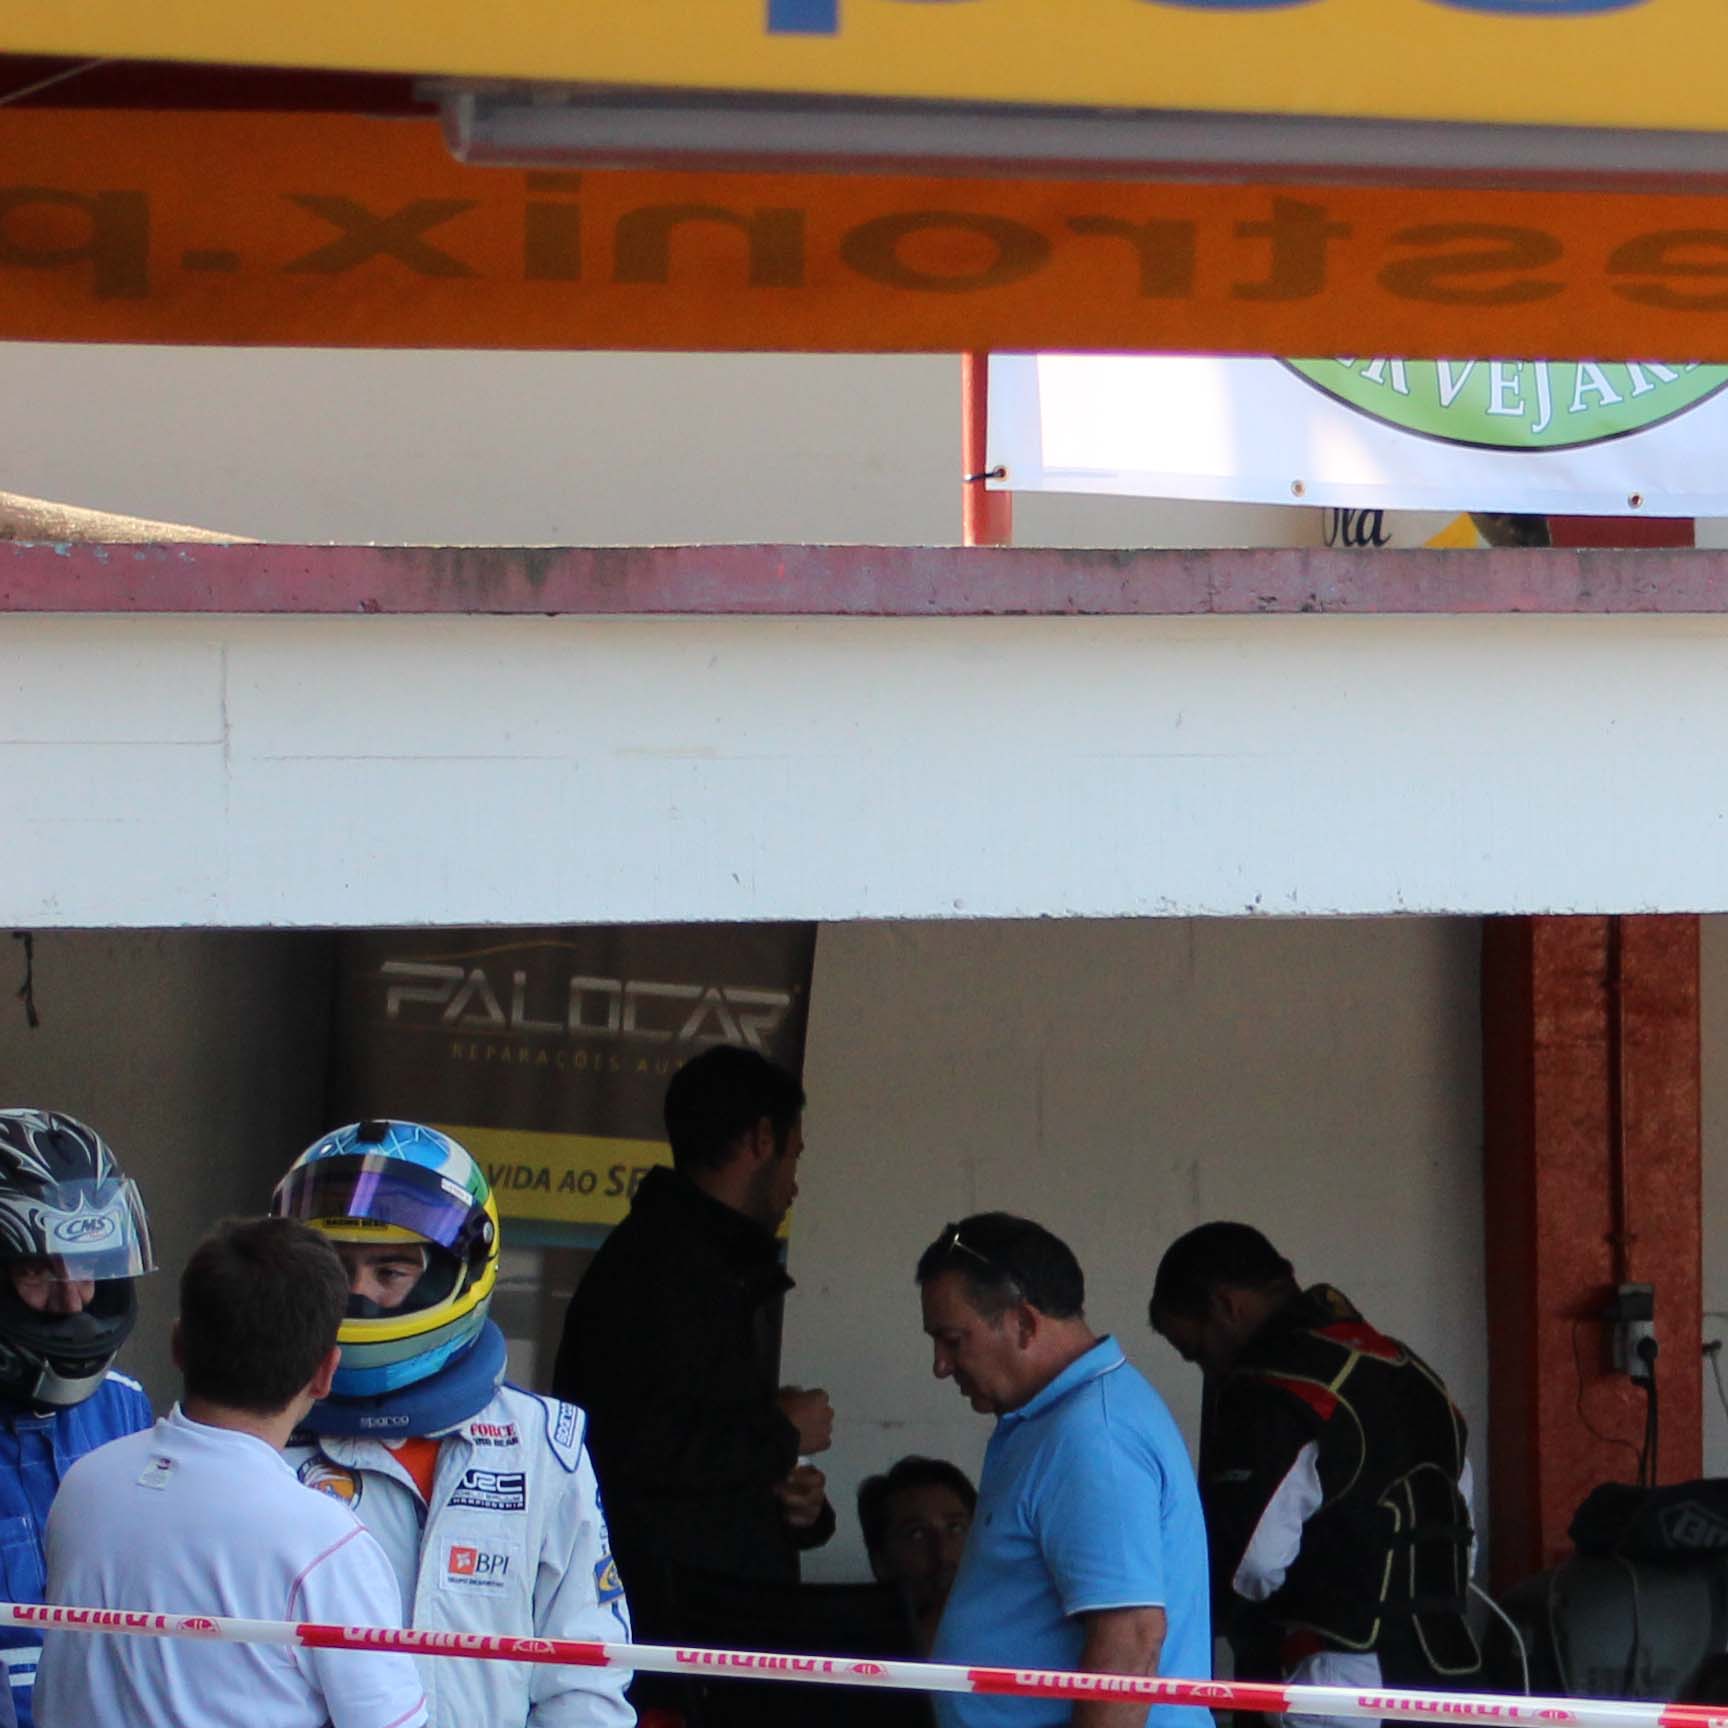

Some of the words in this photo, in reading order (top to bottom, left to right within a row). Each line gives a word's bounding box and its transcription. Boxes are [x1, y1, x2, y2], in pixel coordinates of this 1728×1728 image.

[558, 1168, 598, 1194] AO
[67, 1216, 106, 1235] CMS
[469, 1423, 517, 1437] FORCE
[476, 1552, 510, 1575] BPI
